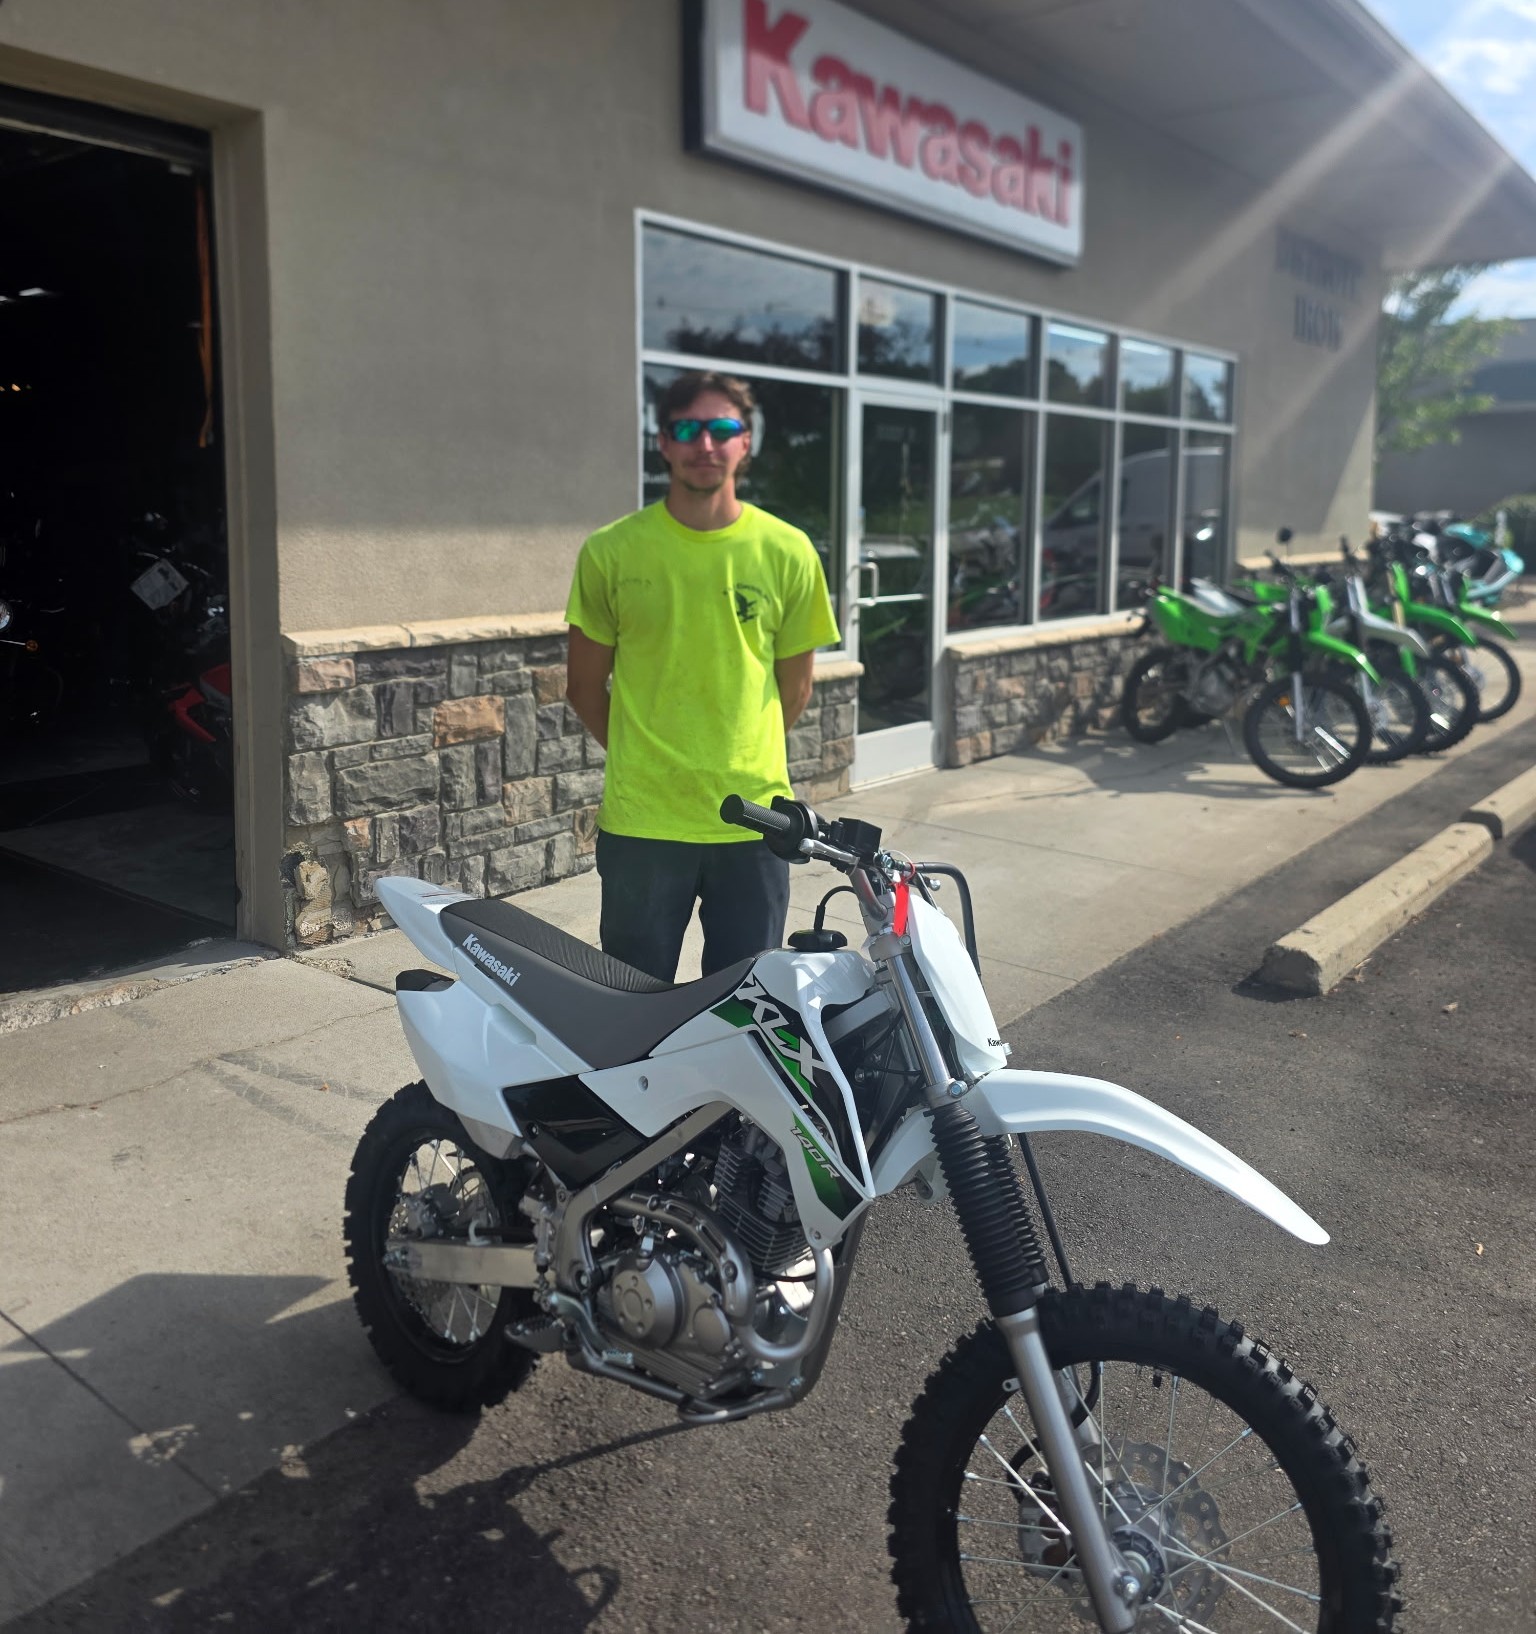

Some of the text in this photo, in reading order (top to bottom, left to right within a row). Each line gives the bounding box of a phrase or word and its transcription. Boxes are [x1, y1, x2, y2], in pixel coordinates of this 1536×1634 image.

[742, 0, 1073, 228] Kawasaki
[462, 933, 521, 987] Kawasaki
[733, 972, 833, 1088] KLX
[790, 1125, 841, 1179] 140R
